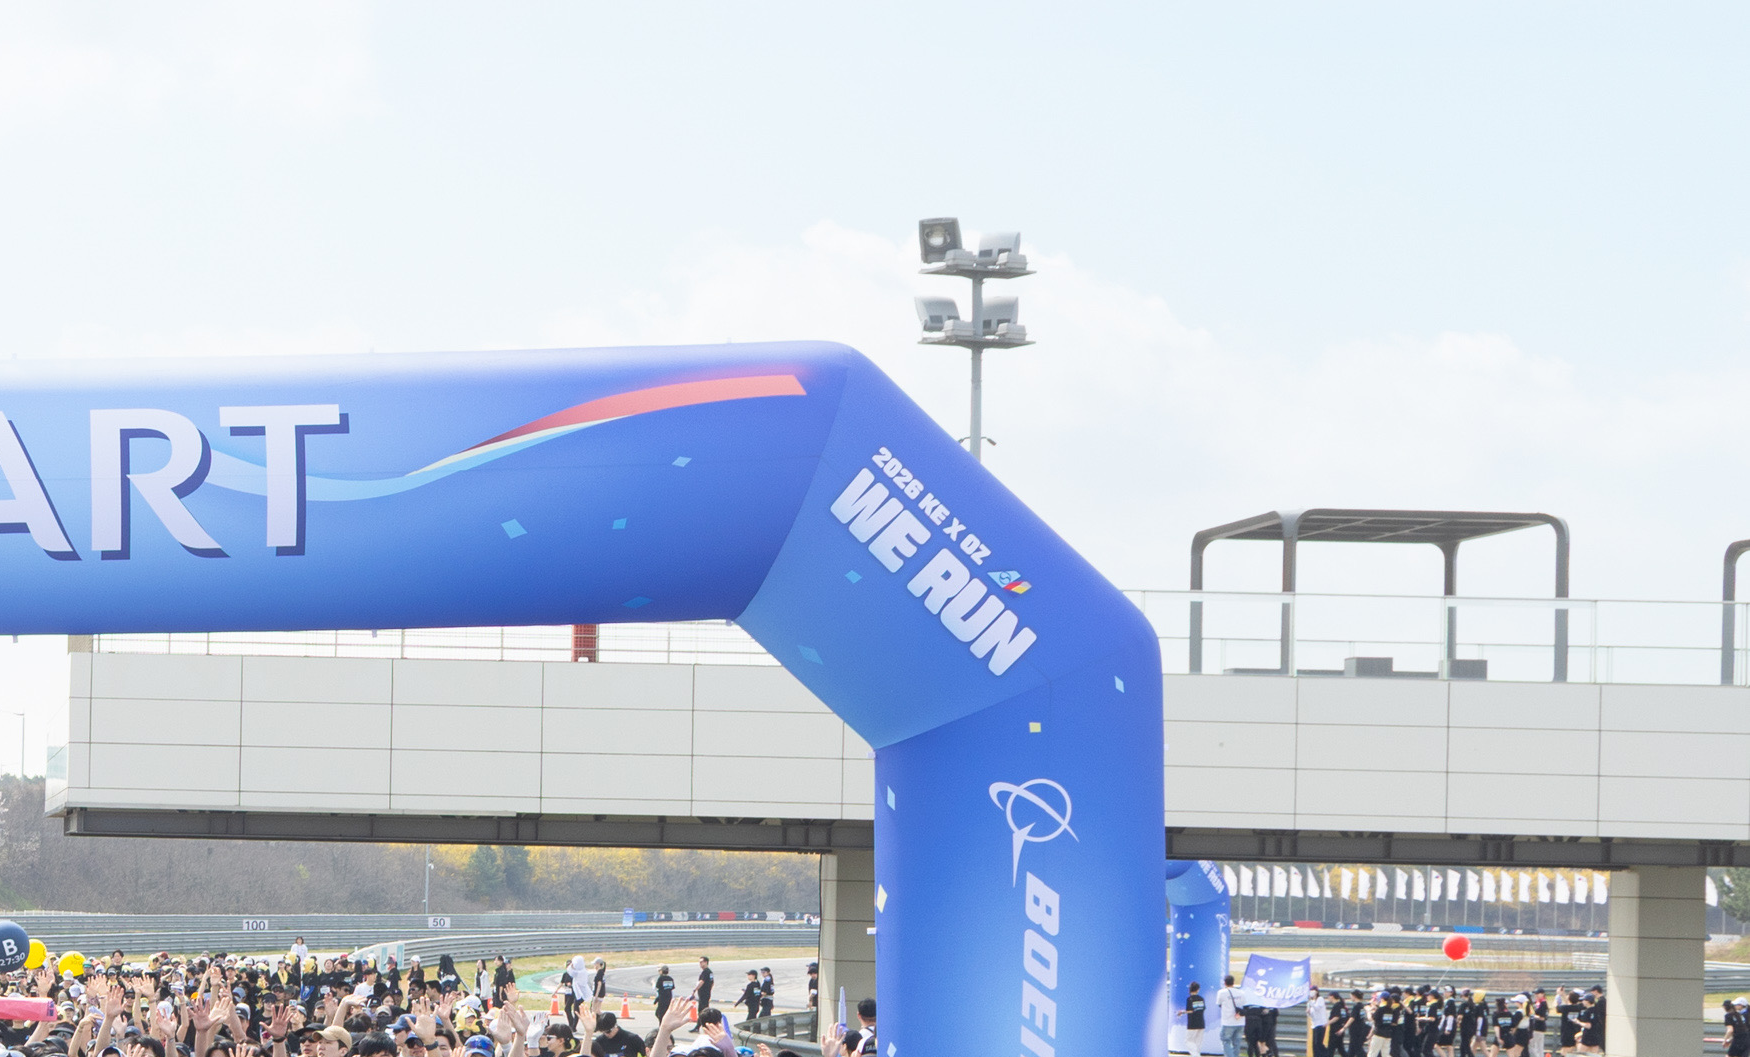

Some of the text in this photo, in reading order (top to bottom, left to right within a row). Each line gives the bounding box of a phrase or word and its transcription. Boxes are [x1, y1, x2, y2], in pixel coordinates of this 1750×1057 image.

[871, 447, 991, 566] 2026 KE X OZ
[830, 467, 1037, 677] WE RUN
[245, 920, 266, 931] 100
[432, 918, 446, 928] 50
[2, 939, 18, 956] B
[0, 952, 25, 966] 27:30
